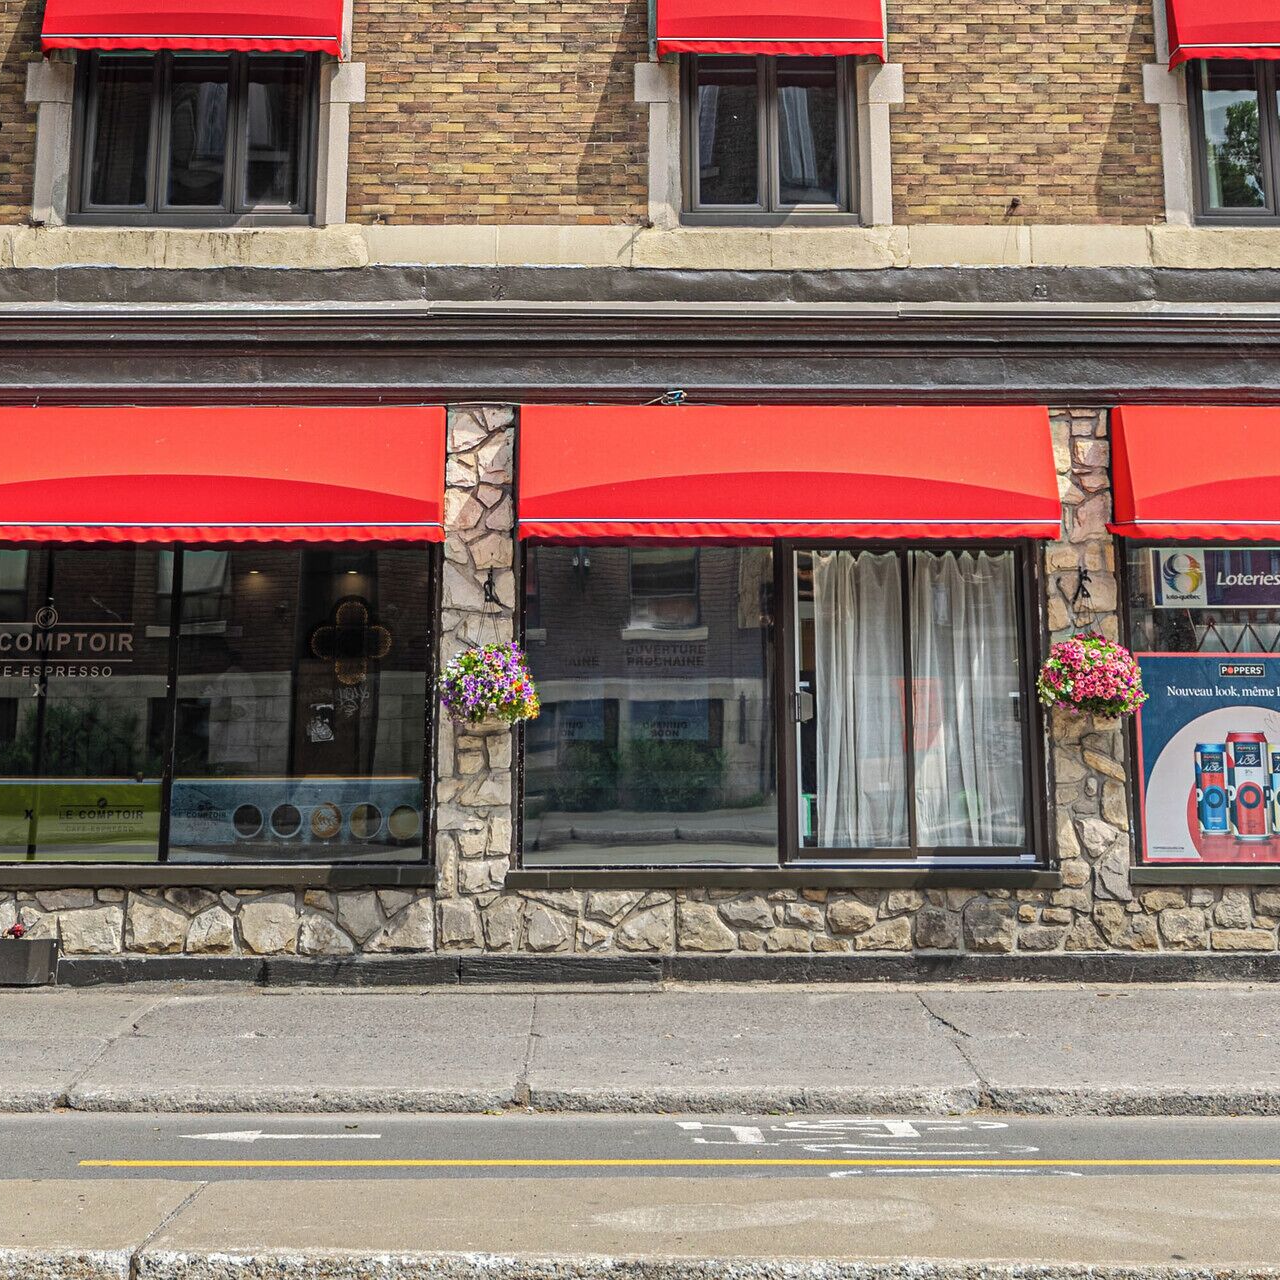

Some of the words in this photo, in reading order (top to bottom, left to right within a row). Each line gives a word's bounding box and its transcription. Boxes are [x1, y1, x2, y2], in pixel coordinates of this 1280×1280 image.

[625, 644, 706, 656] OUVERTURE
[626, 657, 705, 667] PROCHAINE
[1221, 666, 1261, 675] POPPERS
[1167, 685, 1213, 697] Nouveau
[1215, 686, 1240, 698] look,
[1241, 686, 1275, 697] même
[58, 810, 73, 820] LE
[79, 809, 144, 820] COMPTOIR
